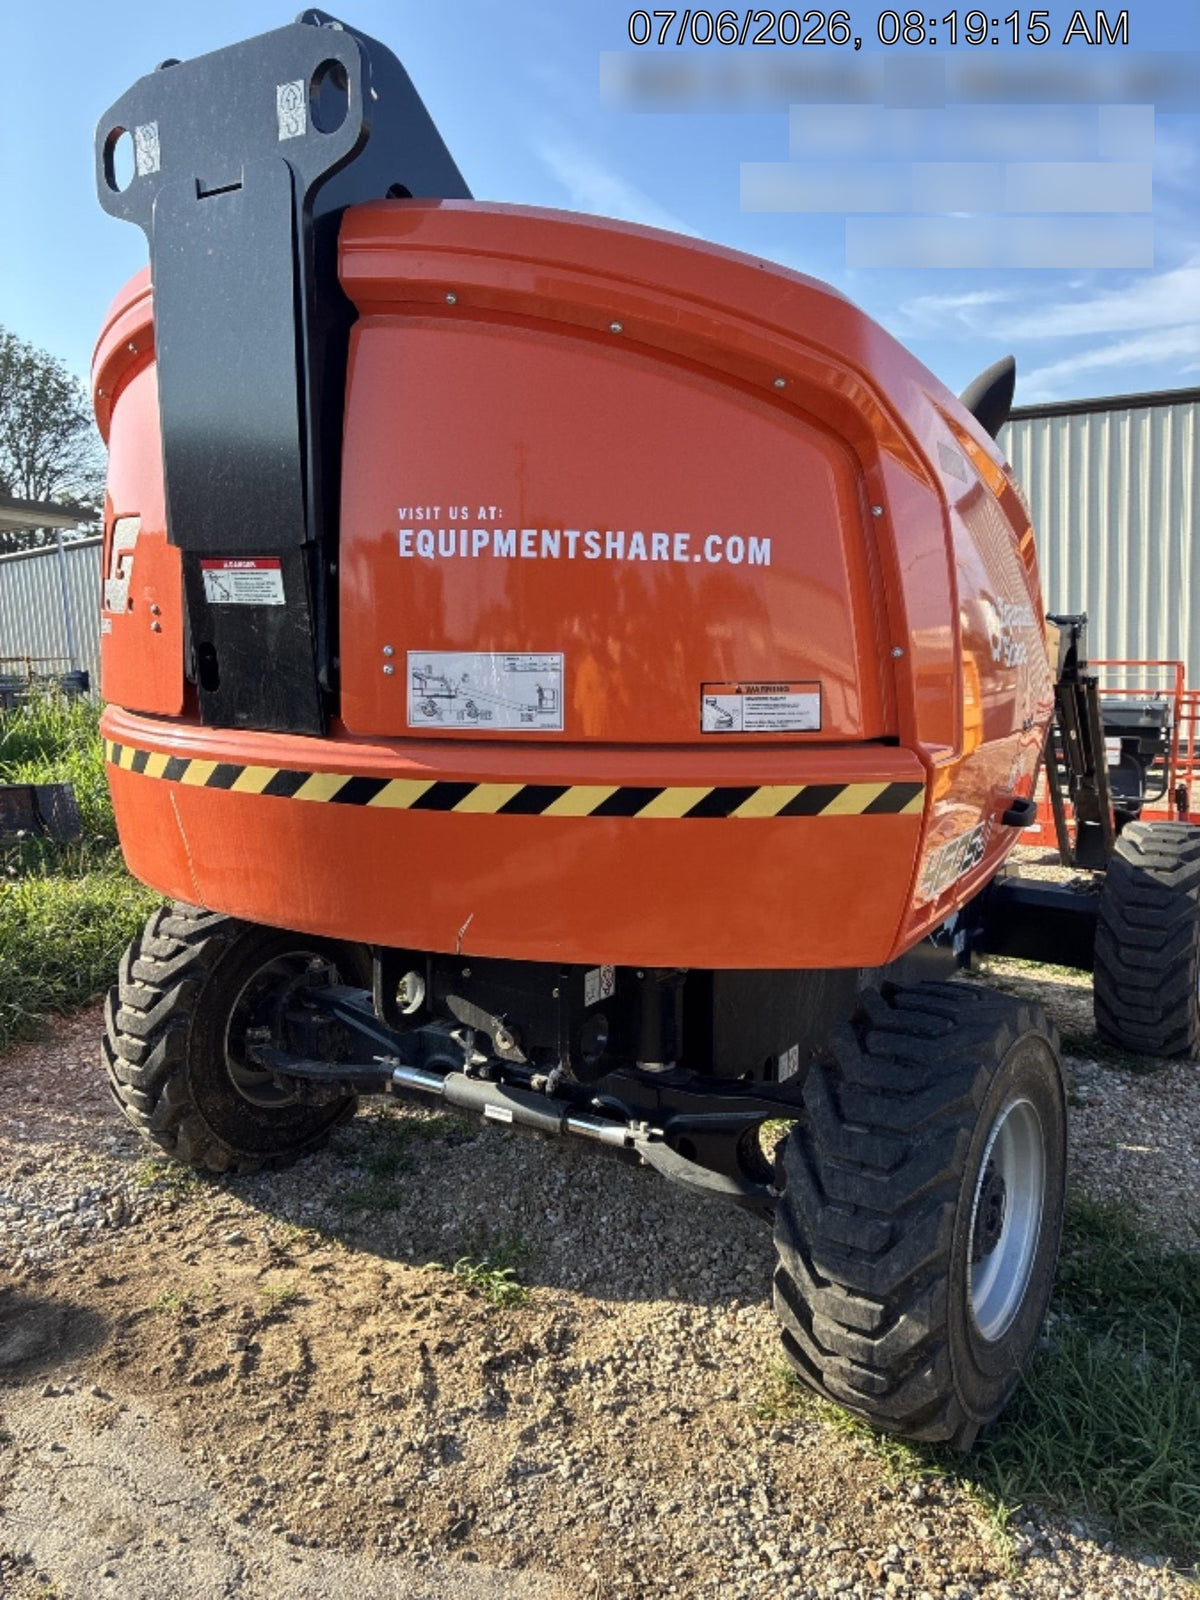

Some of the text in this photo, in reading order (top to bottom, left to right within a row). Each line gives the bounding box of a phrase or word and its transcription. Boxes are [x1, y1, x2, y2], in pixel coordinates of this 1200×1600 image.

[397, 506, 504, 521] VISIT US AT:
[398, 528, 772, 567] EQUIPMENTSHARE.COM
